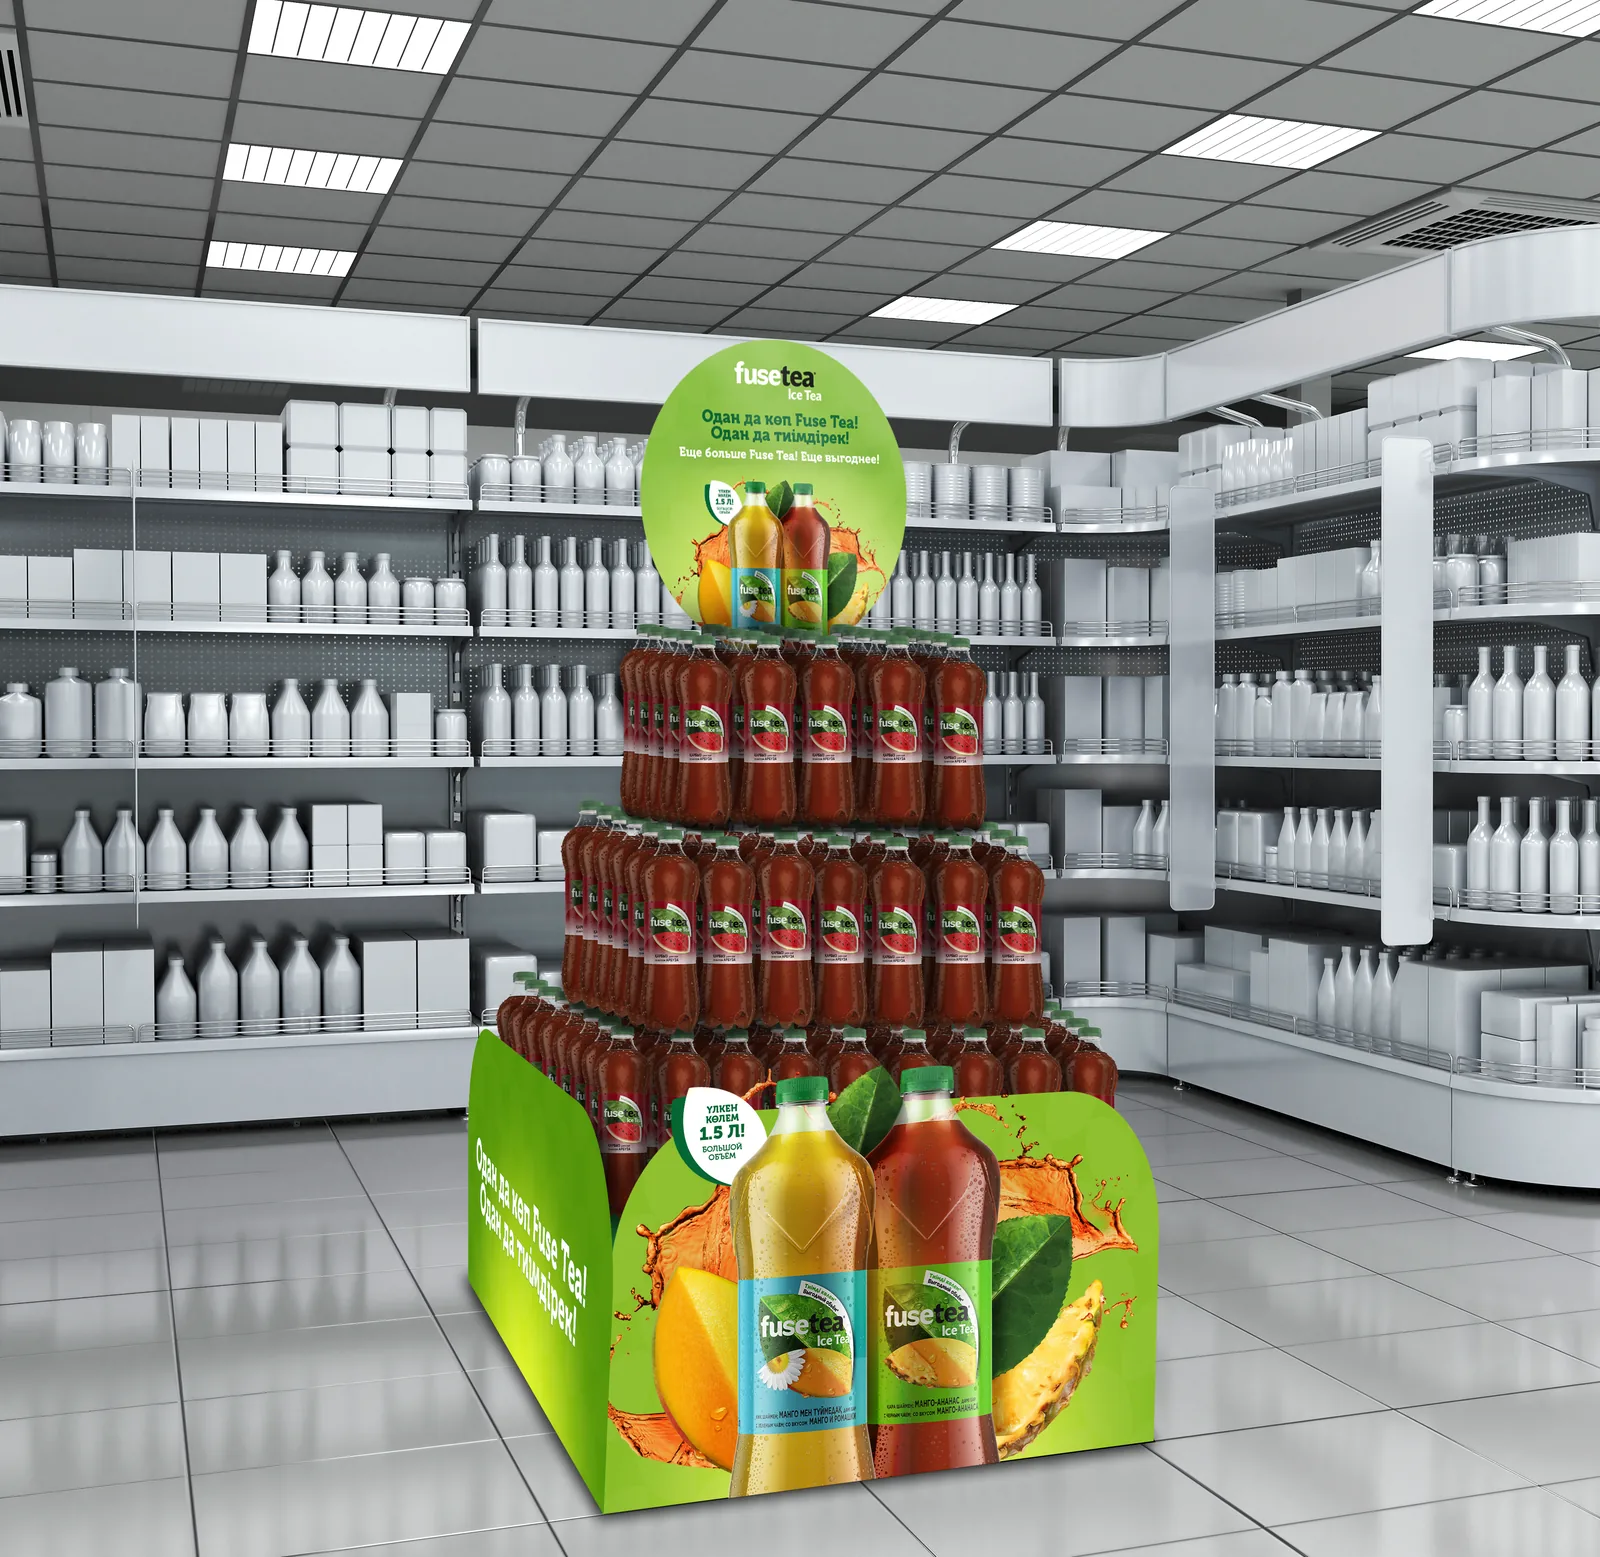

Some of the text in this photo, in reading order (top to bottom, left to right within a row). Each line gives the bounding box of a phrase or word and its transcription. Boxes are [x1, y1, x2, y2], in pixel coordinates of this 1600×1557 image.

[734, 360, 815, 388] fusetea
[788, 388, 822, 401] Ice Tea
[702, 409, 859, 429] Одан да көп Fuse Tea!
[711, 425, 850, 446] Одан да тиімдірек!
[679, 446, 880, 465] Еще больше Fuse Tea! Еще выгоднее!
[685, 718, 720, 728] fusetea
[750, 718, 785, 728] fusetea
[808, 718, 843, 728] fusetea
[879, 718, 914, 728] fusetea
[940, 720, 975, 730] fusetea
[651, 917, 687, 927] fusetea
[709, 919, 744, 928] fusetea
[767, 915, 802, 924] fusetea
[821, 918, 856, 928] fusetea
[879, 920, 913, 929] fusetea
[942, 918, 976, 928] fusetea
[998, 918, 1033, 928] fusetea
[604, 1108, 639, 1118] fusetea
[706, 1103, 738, 1114] ҮЛКЕН
[706, 1113, 740, 1124] КӨЛЕМ
[700, 1123, 745, 1141] 1.5 Л!
[702, 1142, 743, 1153] БОЛЬШОЙ
[708, 1152, 736, 1161] ОБЪЕМ
[476, 1137, 588, 1309] Одан да көп Fuse Tea!
[480, 1182, 577, 1348] Одан да тиімдірек!
[885, 1303, 968, 1328] fusetea
[760, 1313, 844, 1338] fusetea
[942, 1324, 975, 1337] Ice Tea
[817, 1334, 850, 1347] Ice Tea
[914, 1397, 959, 1408] МАНГО-АНАНАС
[779, 1410, 798, 1419] МАНГО
[800, 1408, 812, 1417] МЕН
[809, 1416, 828, 1425] МАНГО
